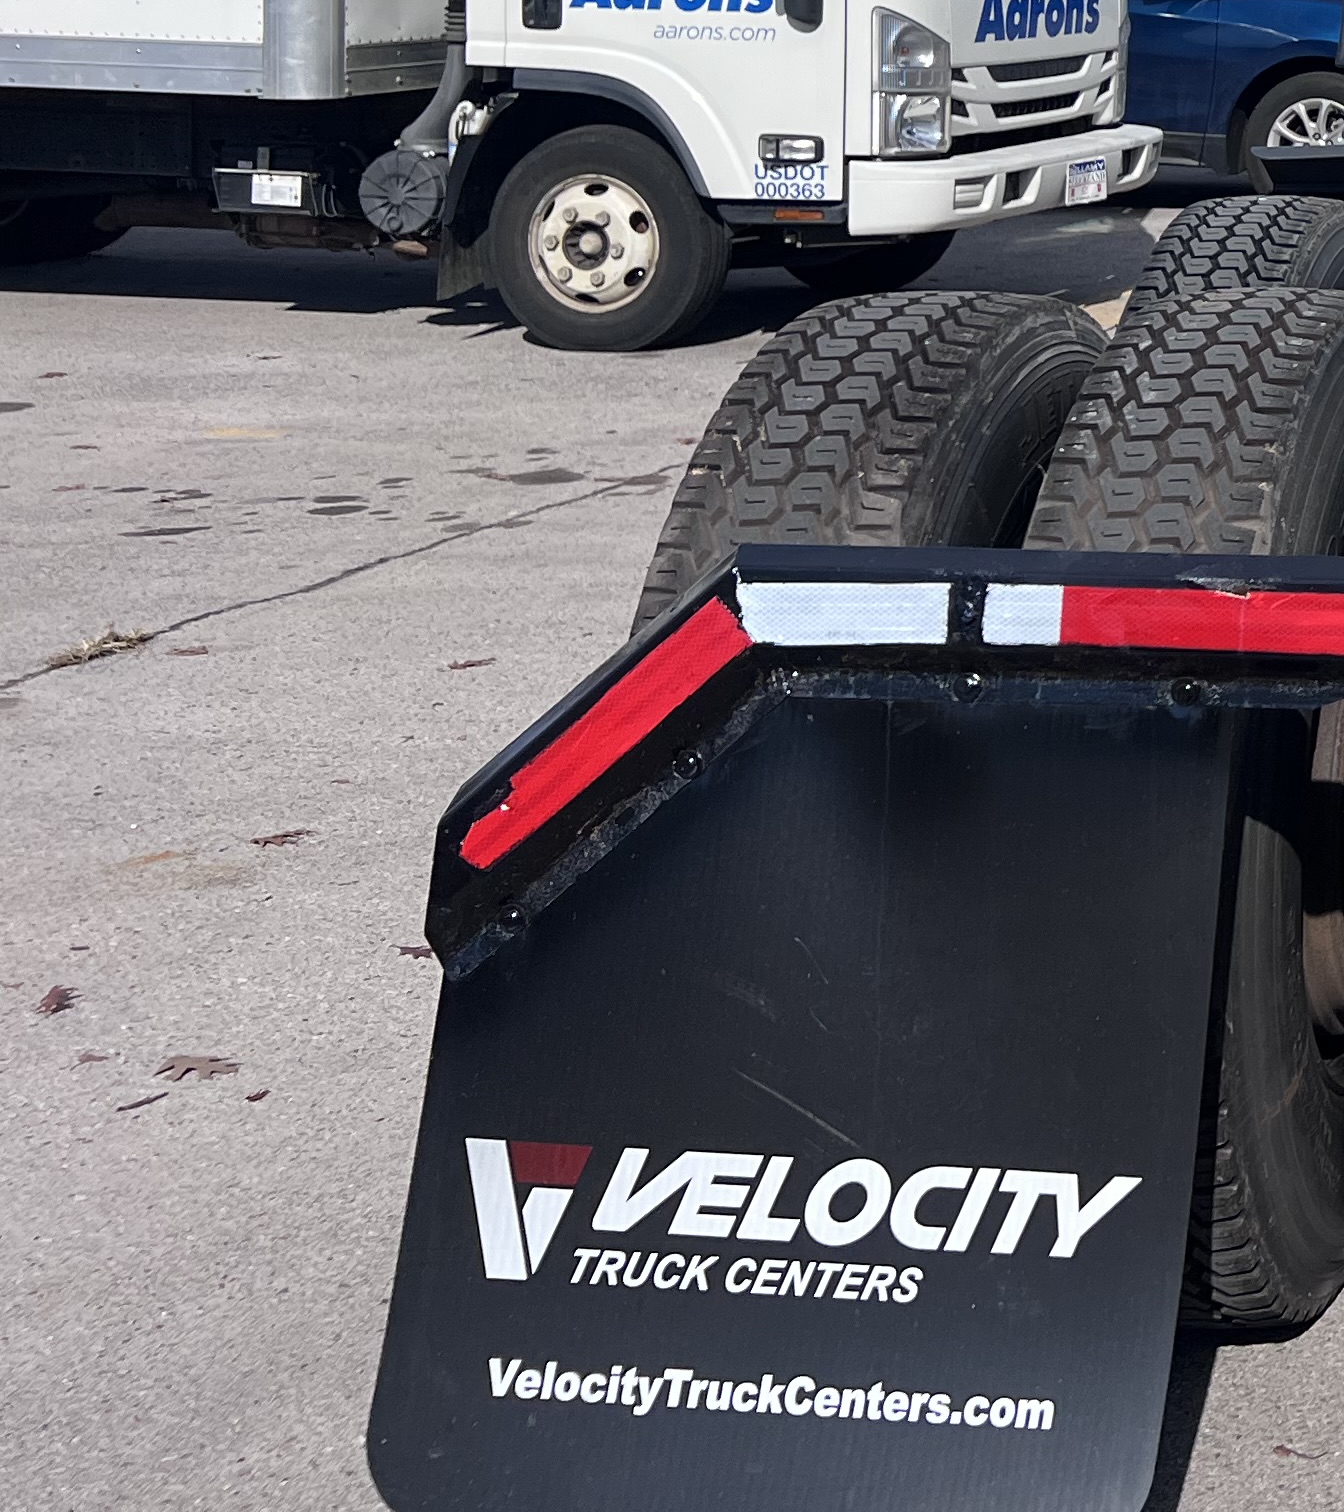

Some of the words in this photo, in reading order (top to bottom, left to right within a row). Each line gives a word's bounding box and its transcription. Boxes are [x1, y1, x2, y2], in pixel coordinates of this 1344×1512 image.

[653, 24, 776, 42] aarons.com
[754, 163, 829, 180] USDOT
[754, 182, 825, 199] 000363
[591, 1147, 1143, 1258] VELOCITY
[570, 1248, 719, 1292] TRUCK
[725, 1256, 924, 1304] CENTERS
[487, 1357, 1056, 1430] VelocityTruckCenters.com
